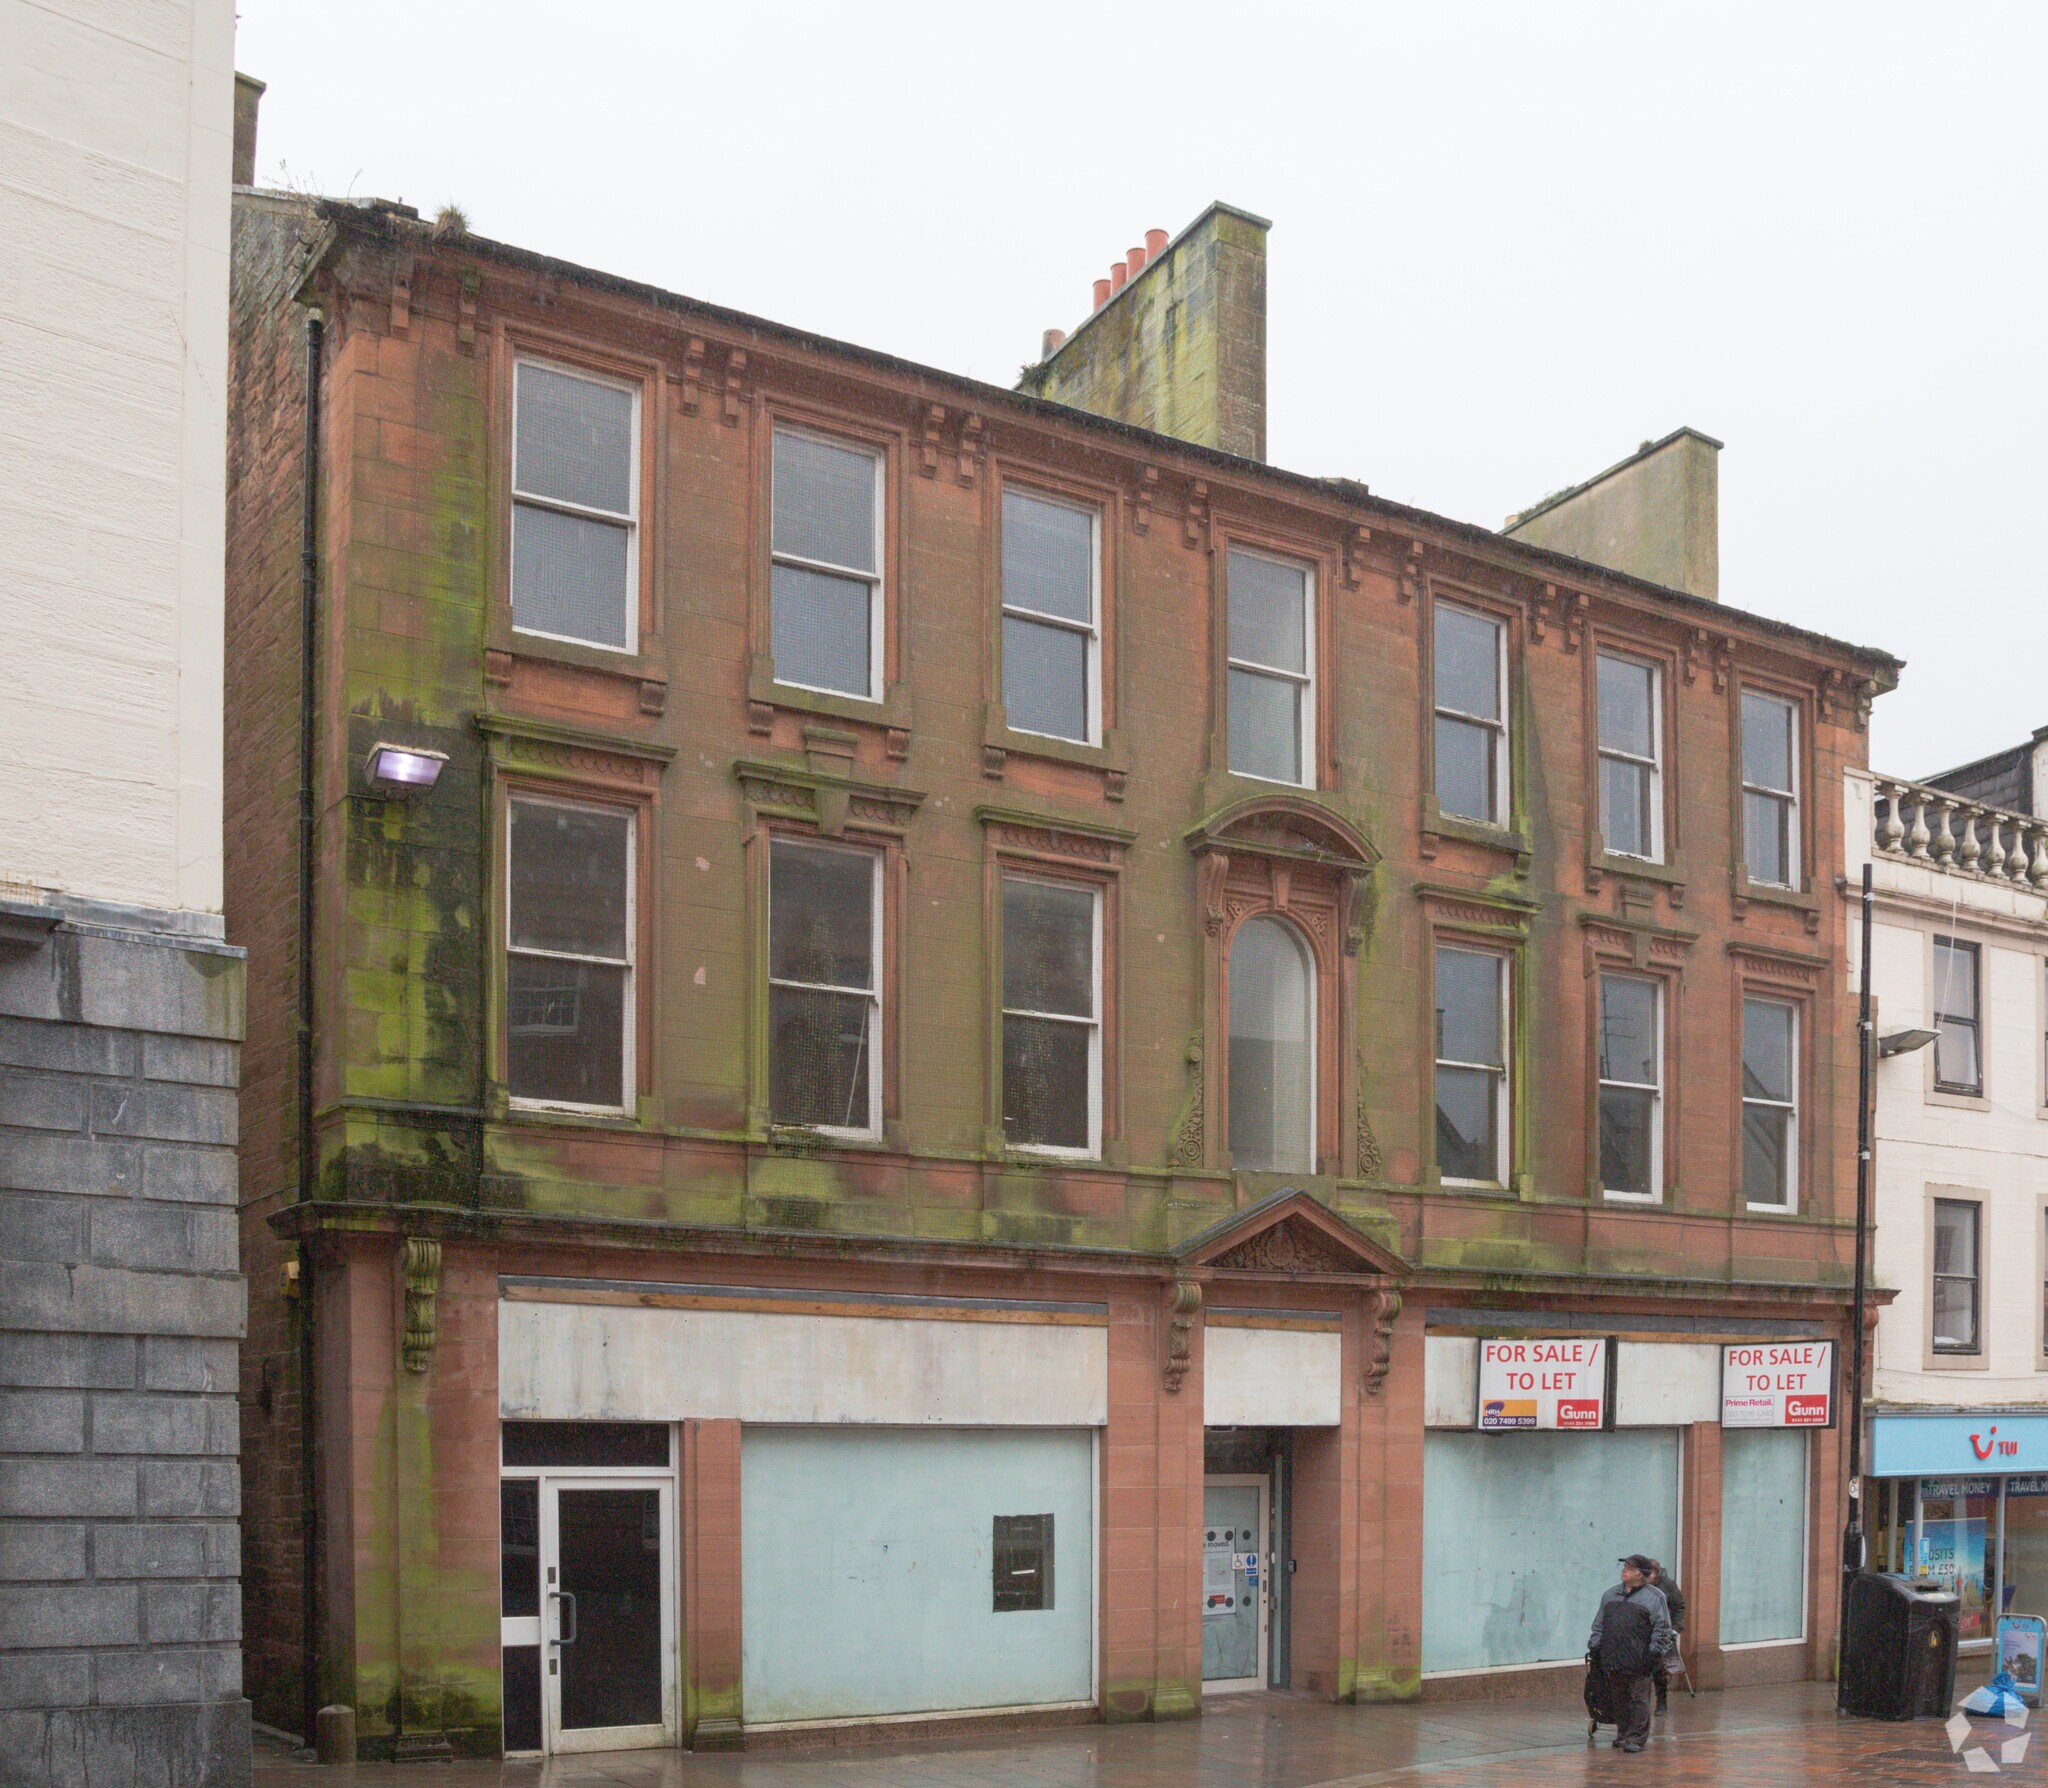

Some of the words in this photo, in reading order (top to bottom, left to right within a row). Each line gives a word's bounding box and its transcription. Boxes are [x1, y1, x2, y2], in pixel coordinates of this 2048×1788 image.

[1486, 1345, 1526, 1363] FOR
[1533, 1344, 1583, 1362] SALE
[1588, 1343, 1599, 1367] /
[1729, 1350, 1763, 1366] FOR
[1769, 1347, 1813, 1365] SALE
[1817, 1346, 1827, 1368] /
[1506, 1372, 1534, 1390] TO
[1542, 1372, 1576, 1390] LET
[1746, 1374, 1771, 1391] TO
[1777, 1373, 1807, 1390] LET
[1725, 1399, 1748, 1407] Prime
[1749, 1398, 1774, 1406] Retail.
[1788, 1401, 1825, 1416] Gunn
[1560, 1404, 1597, 1420] Gunn
[1484, 1417, 1498, 1425] 020
[1499, 1417, 1517, 1425] 7499
[1517, 1417, 1536, 1425] 5399
[1998, 1441, 2018, 1455] TUI
[1928, 1483, 1959, 1496] TRAVEL
[1961, 1482, 1991, 1494] MONEY
[2010, 1481, 2039, 1493] TRAVEL
